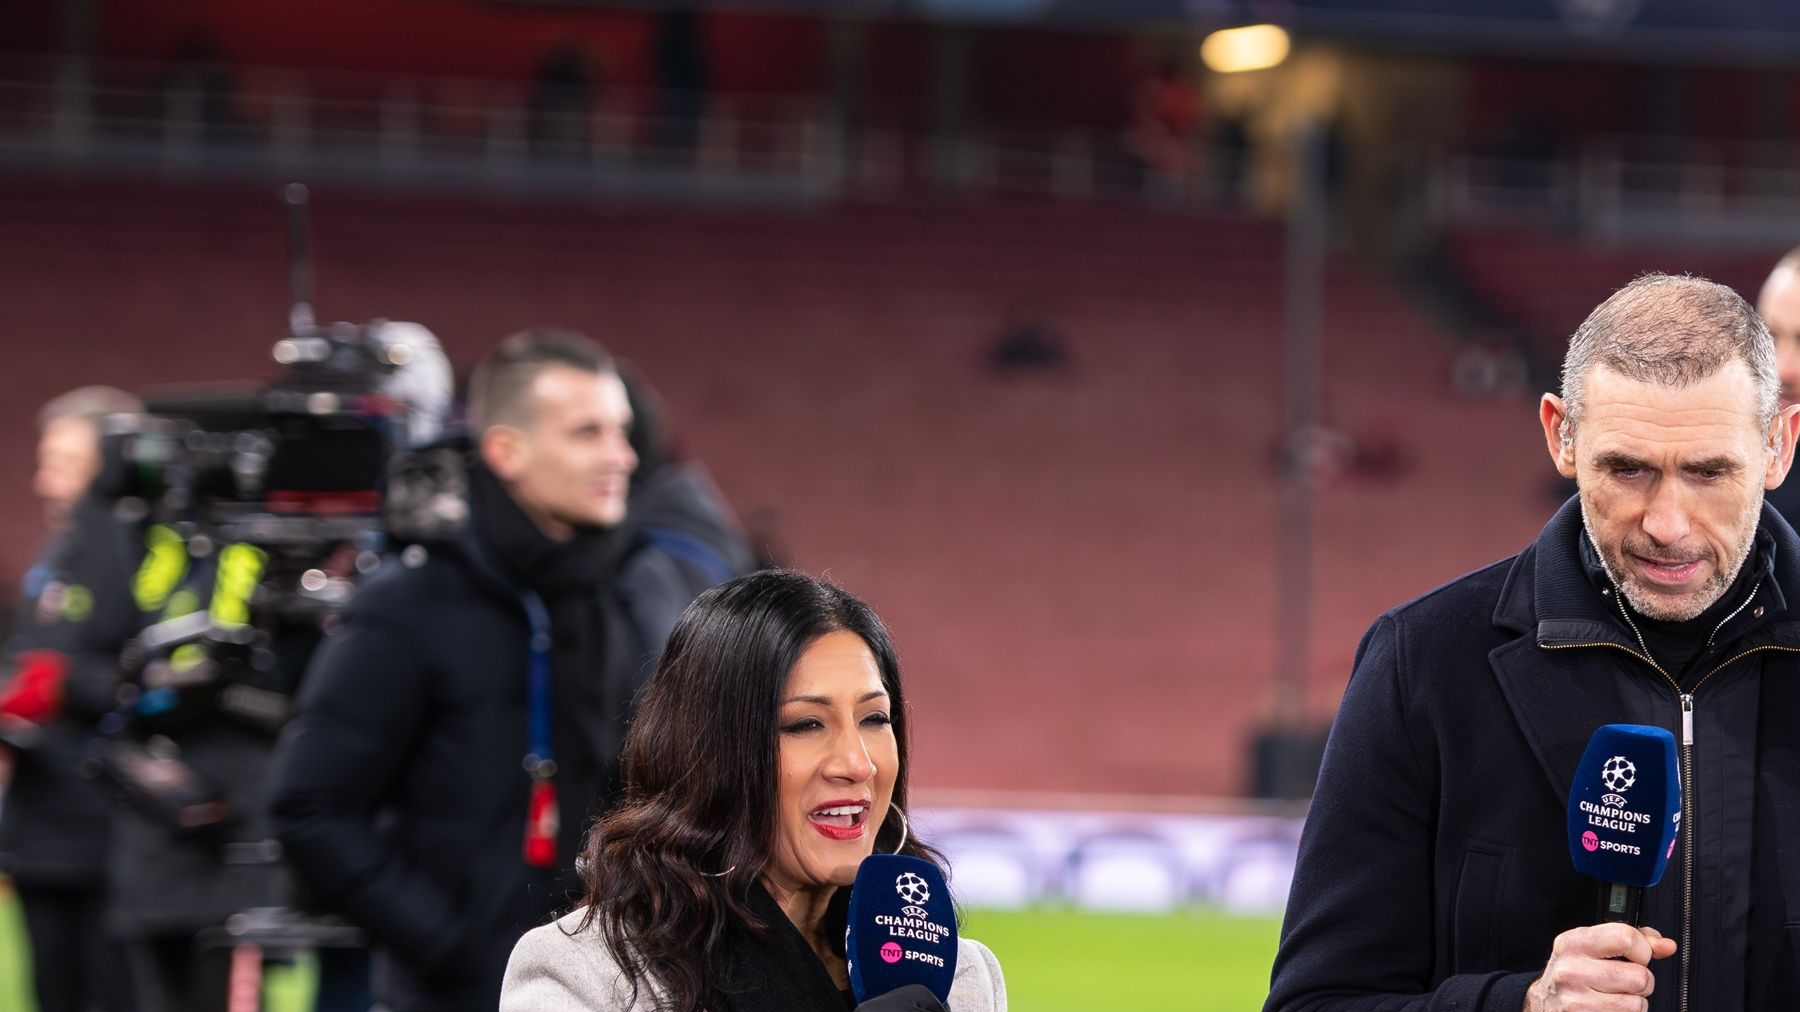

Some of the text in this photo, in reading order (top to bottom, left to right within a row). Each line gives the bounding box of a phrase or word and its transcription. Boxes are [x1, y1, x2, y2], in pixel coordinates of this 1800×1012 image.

[1602, 795, 1625, 807] UEFA
[1579, 800, 1651, 824] CHAMPIONS
[1588, 814, 1636, 833] LEAGUE
[1582, 837, 1641, 855] TNT SPORTS
[904, 907, 928, 919] UEFA
[875, 915, 950, 937] CHAMPIONS
[889, 926, 940, 944] LEAGUE
[881, 948, 944, 967] TNT SPORTS
